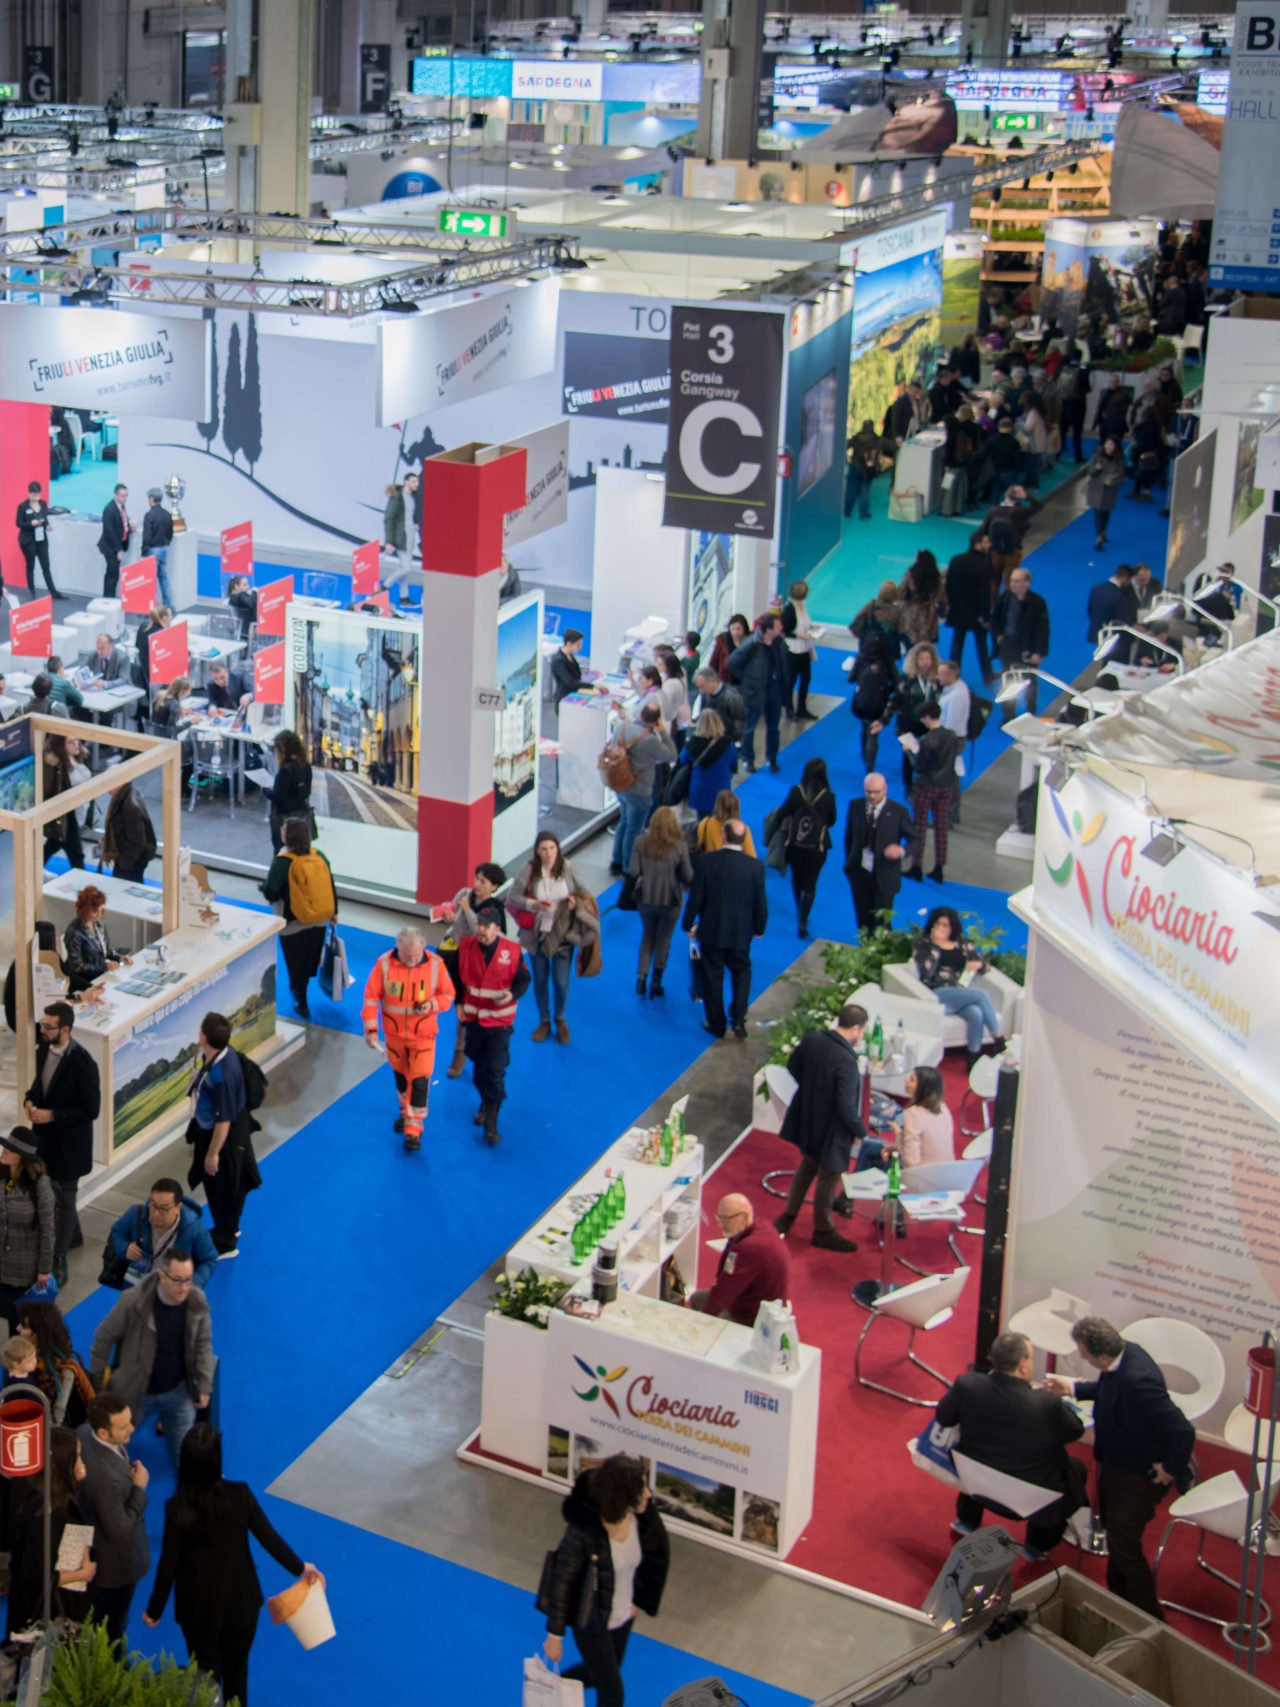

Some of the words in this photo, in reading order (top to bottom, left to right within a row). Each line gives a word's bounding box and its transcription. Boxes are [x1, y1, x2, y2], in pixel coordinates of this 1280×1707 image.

[1246, 16, 1280, 50] B
[370, 49, 378, 62] 3
[29, 72, 51, 102] G
[366, 73, 386, 102] F
[517, 76, 593, 89] SARDEGNA
[462, 336, 488, 366] VENEZIA
[488, 315, 509, 347] GIULIA
[683, 322, 700, 332] Pad
[708, 324, 734, 364] 3
[38, 364, 74, 383] FRIULI
[75, 350, 124, 375] VENEZIA
[126, 341, 166, 363] GIULIA
[680, 383, 740, 401] Gangway
[681, 370, 723, 385] Corsia
[571, 388, 601, 406] FRIULI
[601, 381, 640, 402] VENEZIA
[679, 400, 763, 495] C
[479, 692, 500, 706] C77
[1102, 834, 1239, 965] Ciociaria
[626, 1375, 740, 1428] Ciociaria
[744, 1389, 779, 1414] FIUGGI
[589, 1415, 750, 1476] www.ciociariaterradeicammini.it
[637, 1410, 673, 1432] TERRA
[674, 1421, 694, 1438] DEI
[694, 1429, 751, 1457] CAMMINI
